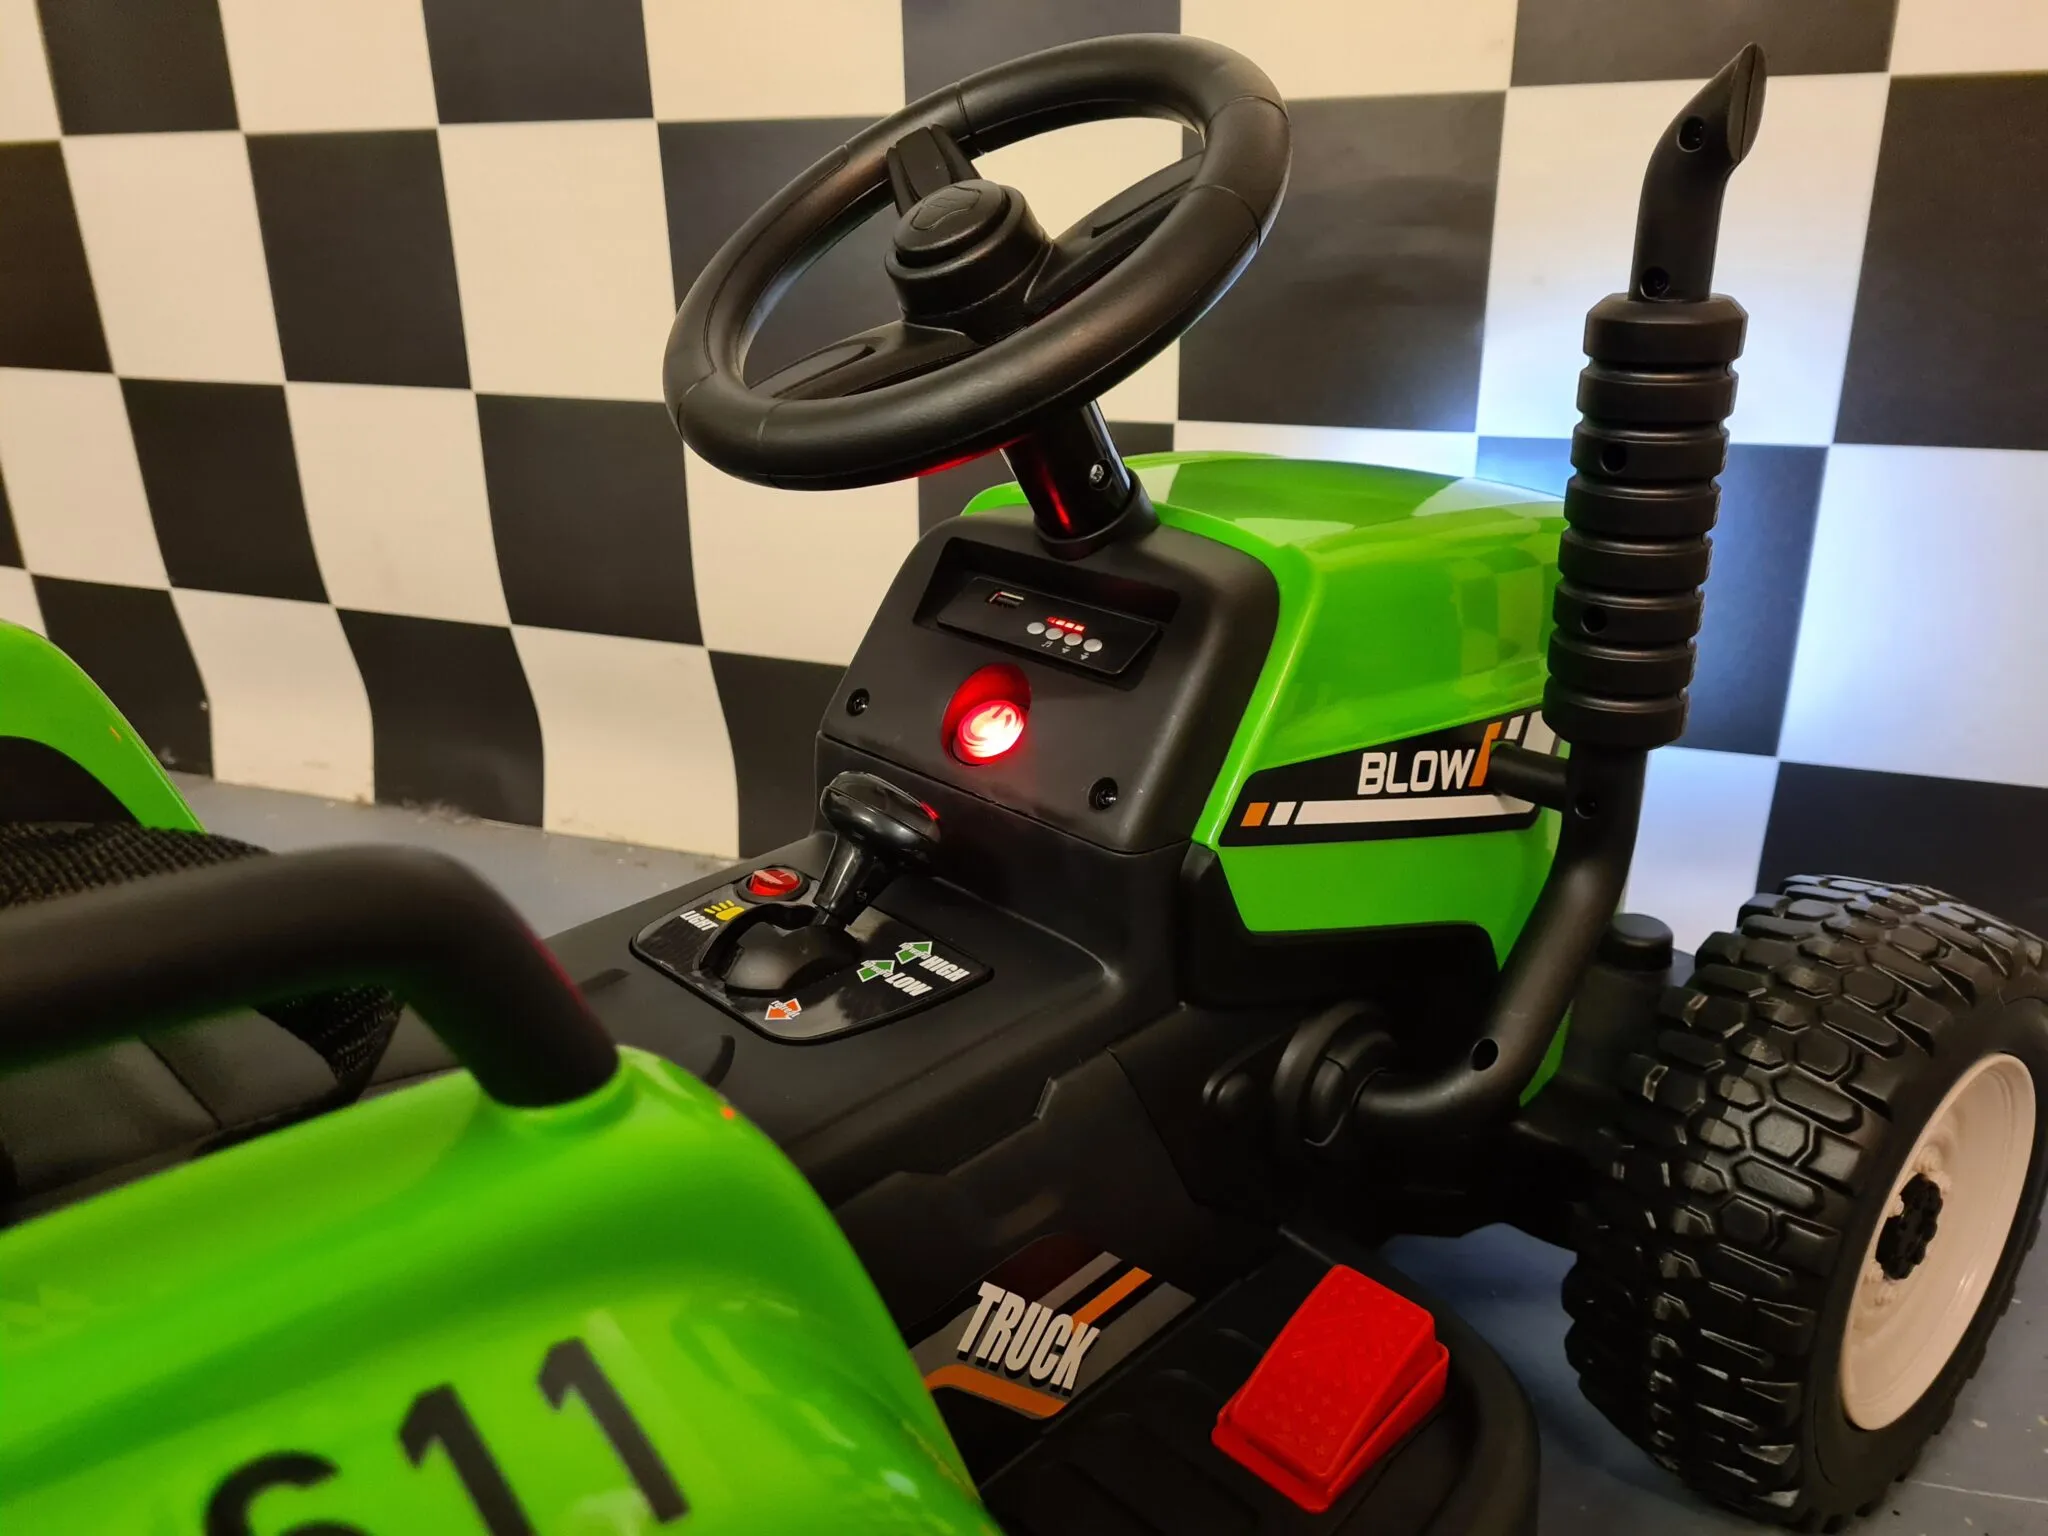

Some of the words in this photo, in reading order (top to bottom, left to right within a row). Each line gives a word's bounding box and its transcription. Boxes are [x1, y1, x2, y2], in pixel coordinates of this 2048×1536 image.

[1357, 749, 1476, 795] BLOW
[680, 910, 719, 931] LIGHT
[919, 955, 970, 982] HIGH
[884, 972, 933, 997] LOW
[957, 1281, 1100, 1393] TRUCK
